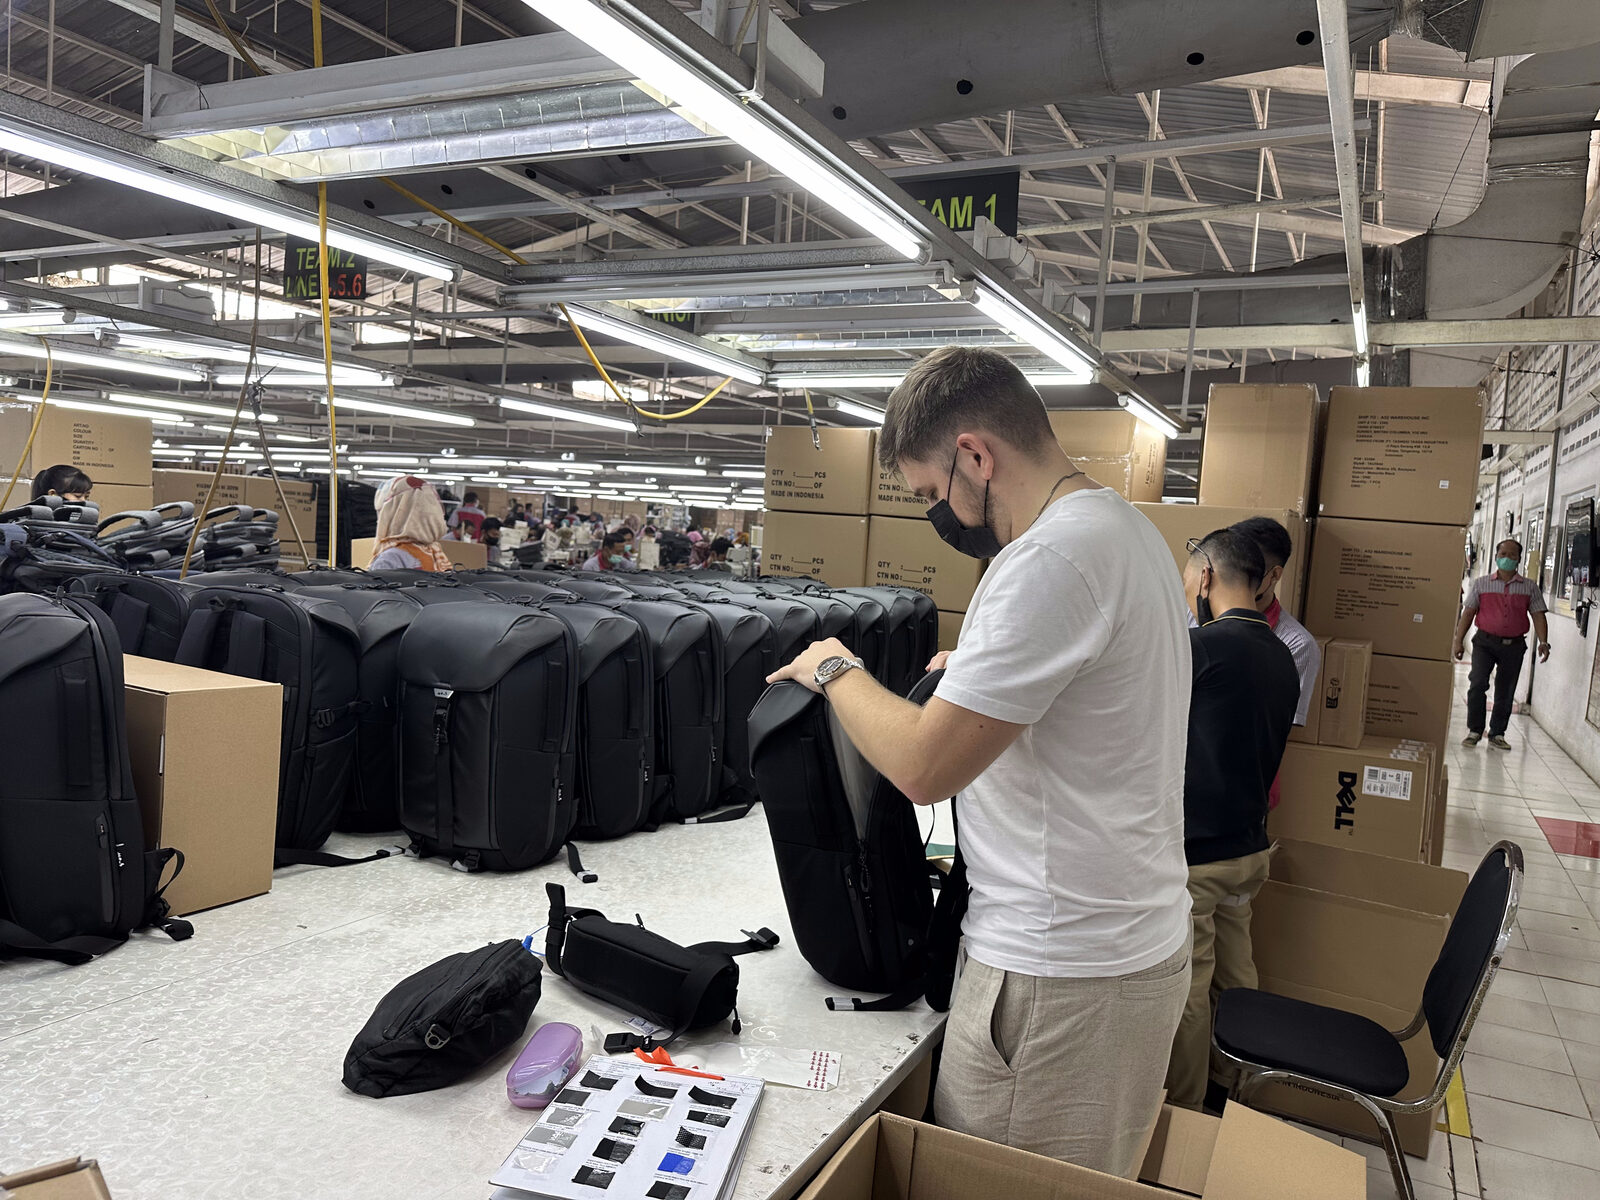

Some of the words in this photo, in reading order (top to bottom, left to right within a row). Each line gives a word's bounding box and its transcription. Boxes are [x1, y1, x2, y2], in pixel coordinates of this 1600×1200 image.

[918, 196, 973, 229] AM
[985, 193, 997, 225] 1
[814, 471, 826, 479] PCS
[794, 491, 824, 499] INDONESIA
[878, 494, 893, 502] MADE
[902, 496, 930, 505] INDONES
[812, 557, 824, 565] PCS
[878, 560, 891, 568] QTY
[923, 565, 936, 574] PCS
[877, 571, 889, 579] CTN
[922, 576, 932, 584] OF
[1335, 771, 1357, 830] DELL
